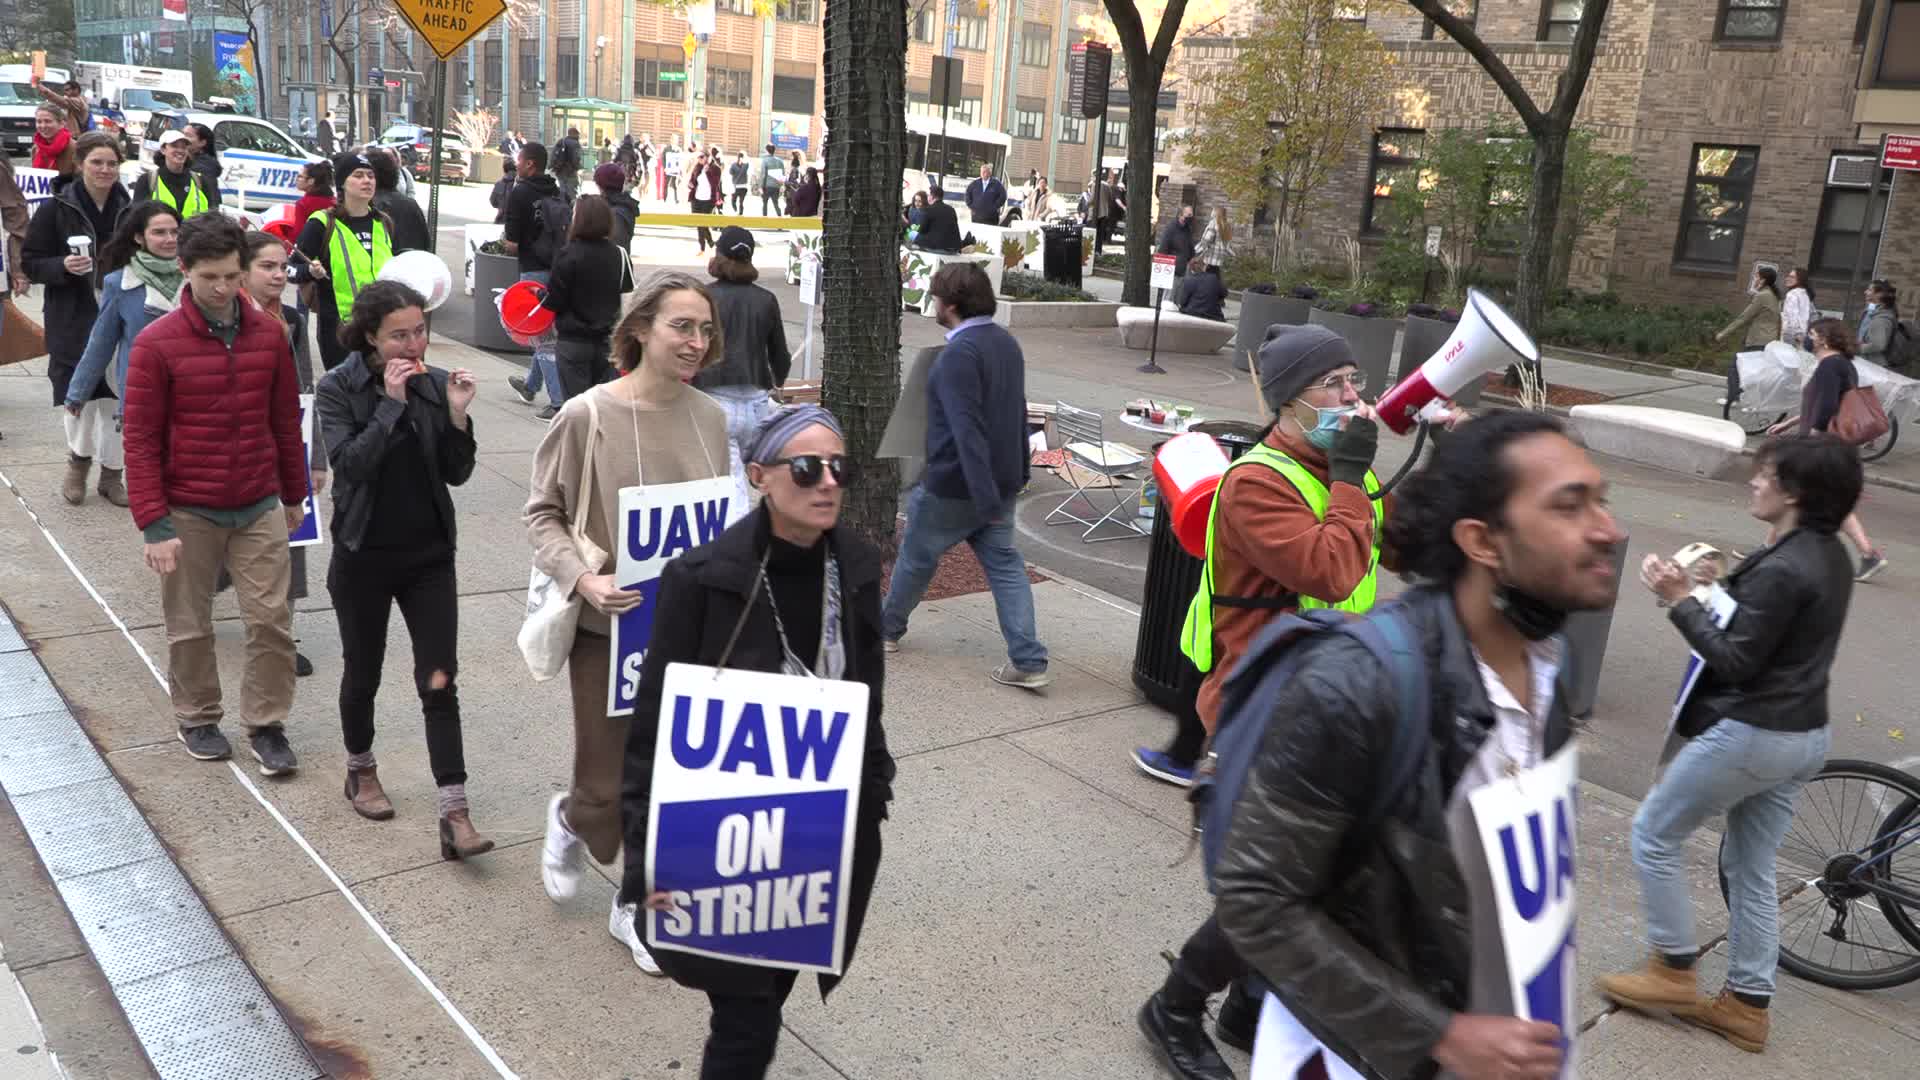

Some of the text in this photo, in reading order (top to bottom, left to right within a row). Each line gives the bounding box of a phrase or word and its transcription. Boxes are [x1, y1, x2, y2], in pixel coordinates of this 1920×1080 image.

[422, 12, 468, 32] AHEAD
[1887, 145, 1913, 153] Anytime
[16, 174, 51, 195] UAW
[627, 497, 730, 562] UAW
[670, 694, 850, 783] UAW
[715, 807, 785, 878] ON
[1497, 783, 1577, 921] UA
[663, 870, 832, 937] STRIKE
